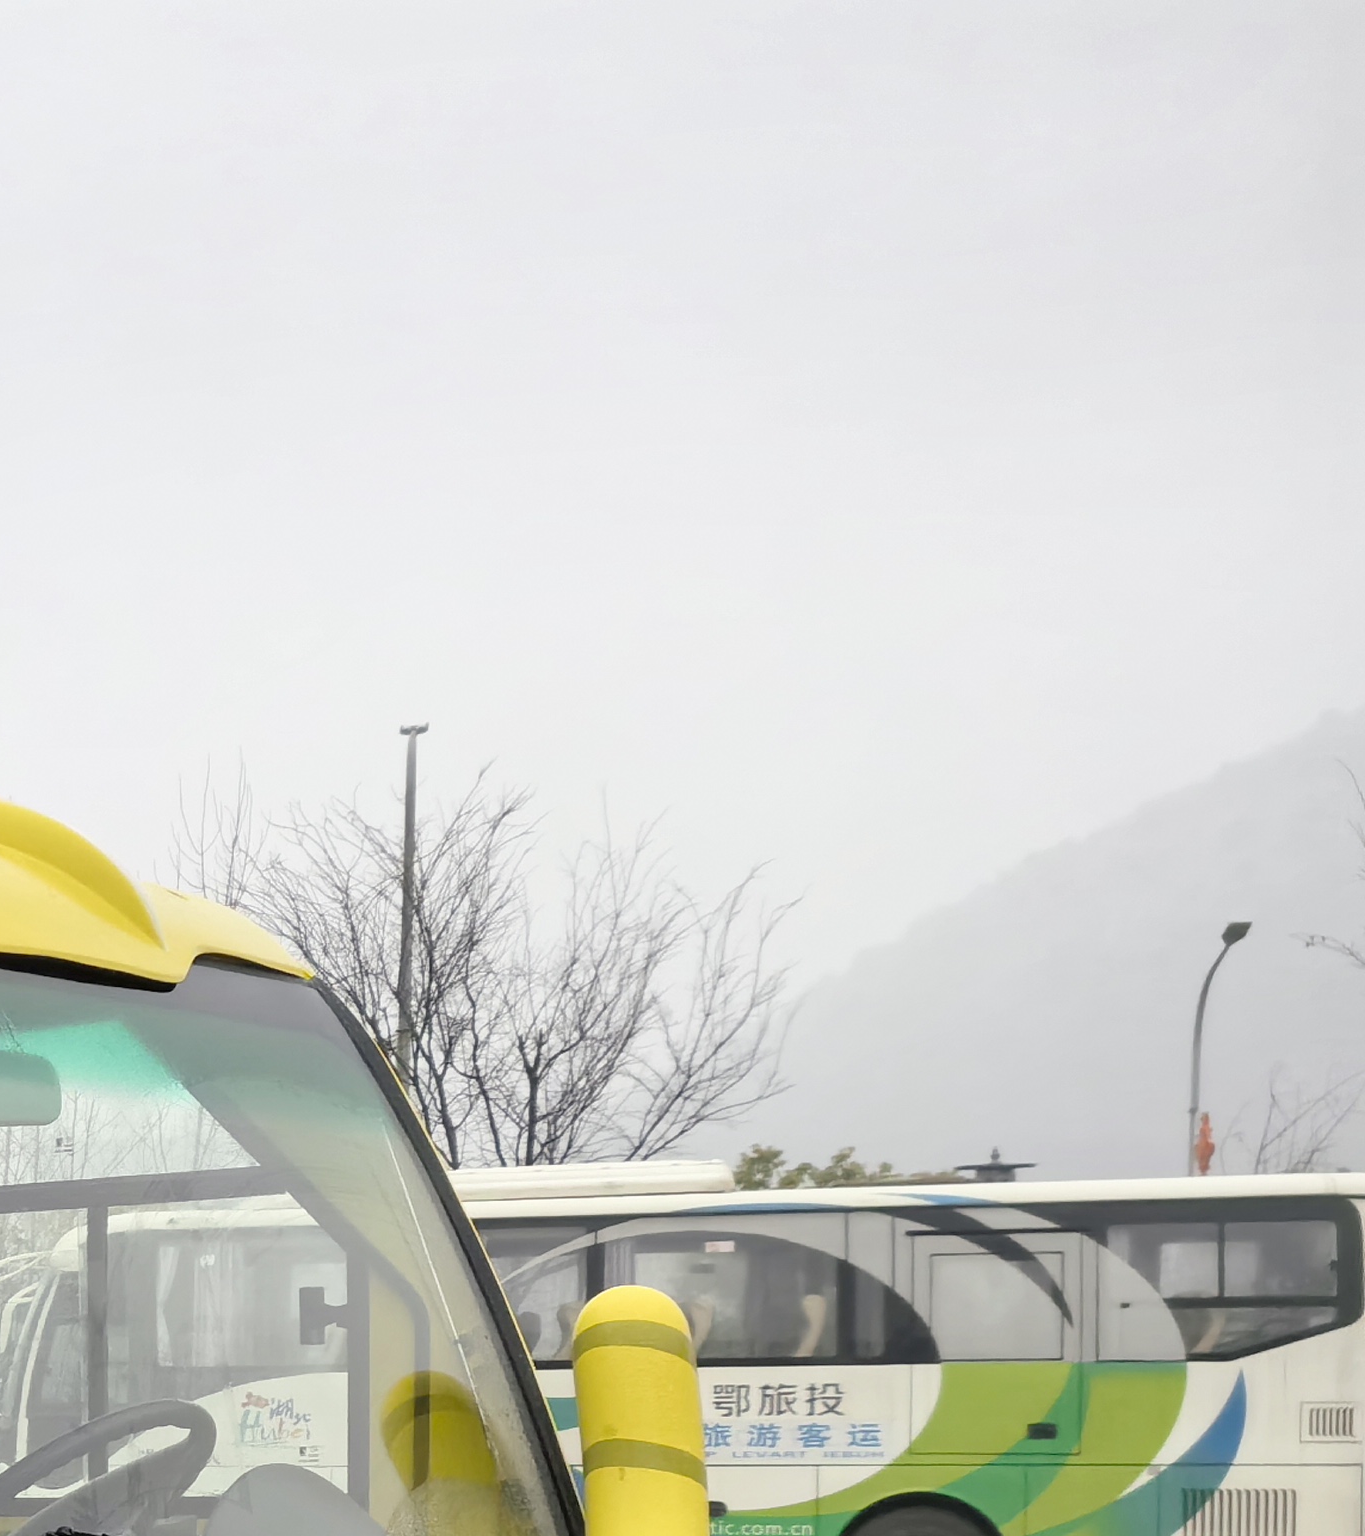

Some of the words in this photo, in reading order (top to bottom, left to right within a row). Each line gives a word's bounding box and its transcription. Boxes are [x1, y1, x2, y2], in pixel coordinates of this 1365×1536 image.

[712, 1383, 846, 1417] 鄂旅投
[703, 1423, 883, 1448] 旅游客运
